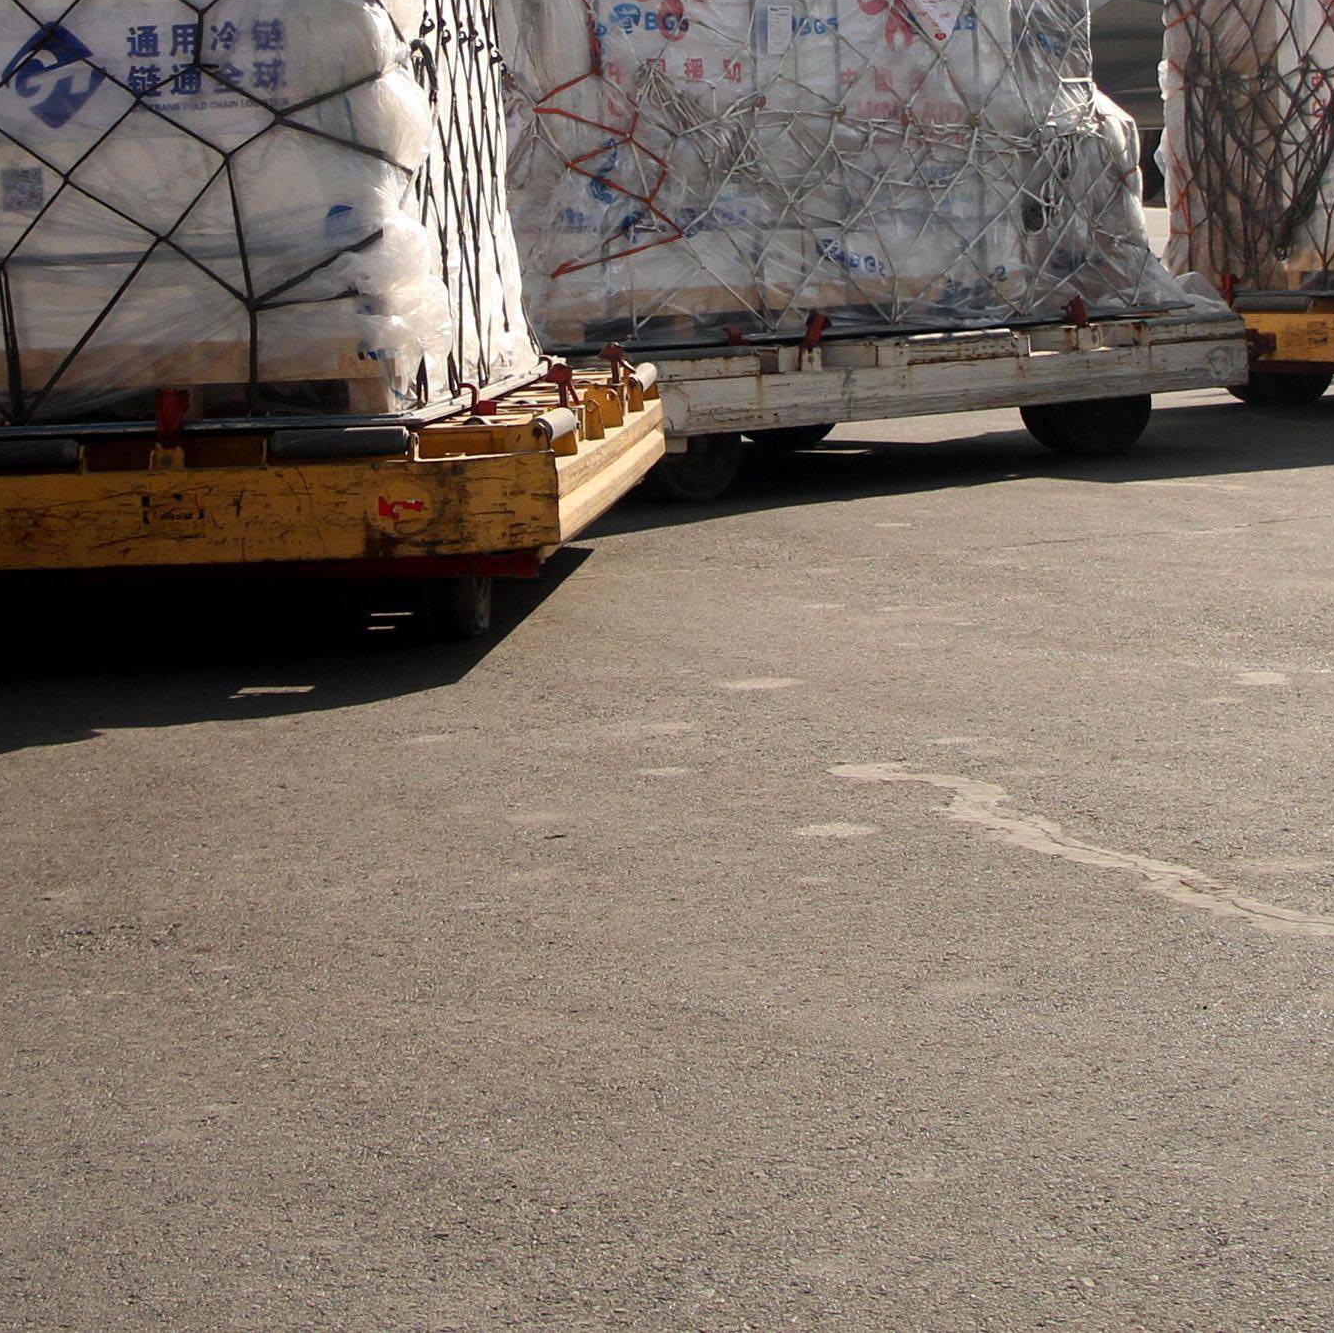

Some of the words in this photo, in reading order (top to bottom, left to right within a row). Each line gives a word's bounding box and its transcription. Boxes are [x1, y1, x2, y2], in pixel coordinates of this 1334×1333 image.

[126, 18, 285, 57] 通用冷链
[210, 97, 240, 109] CHAIN
